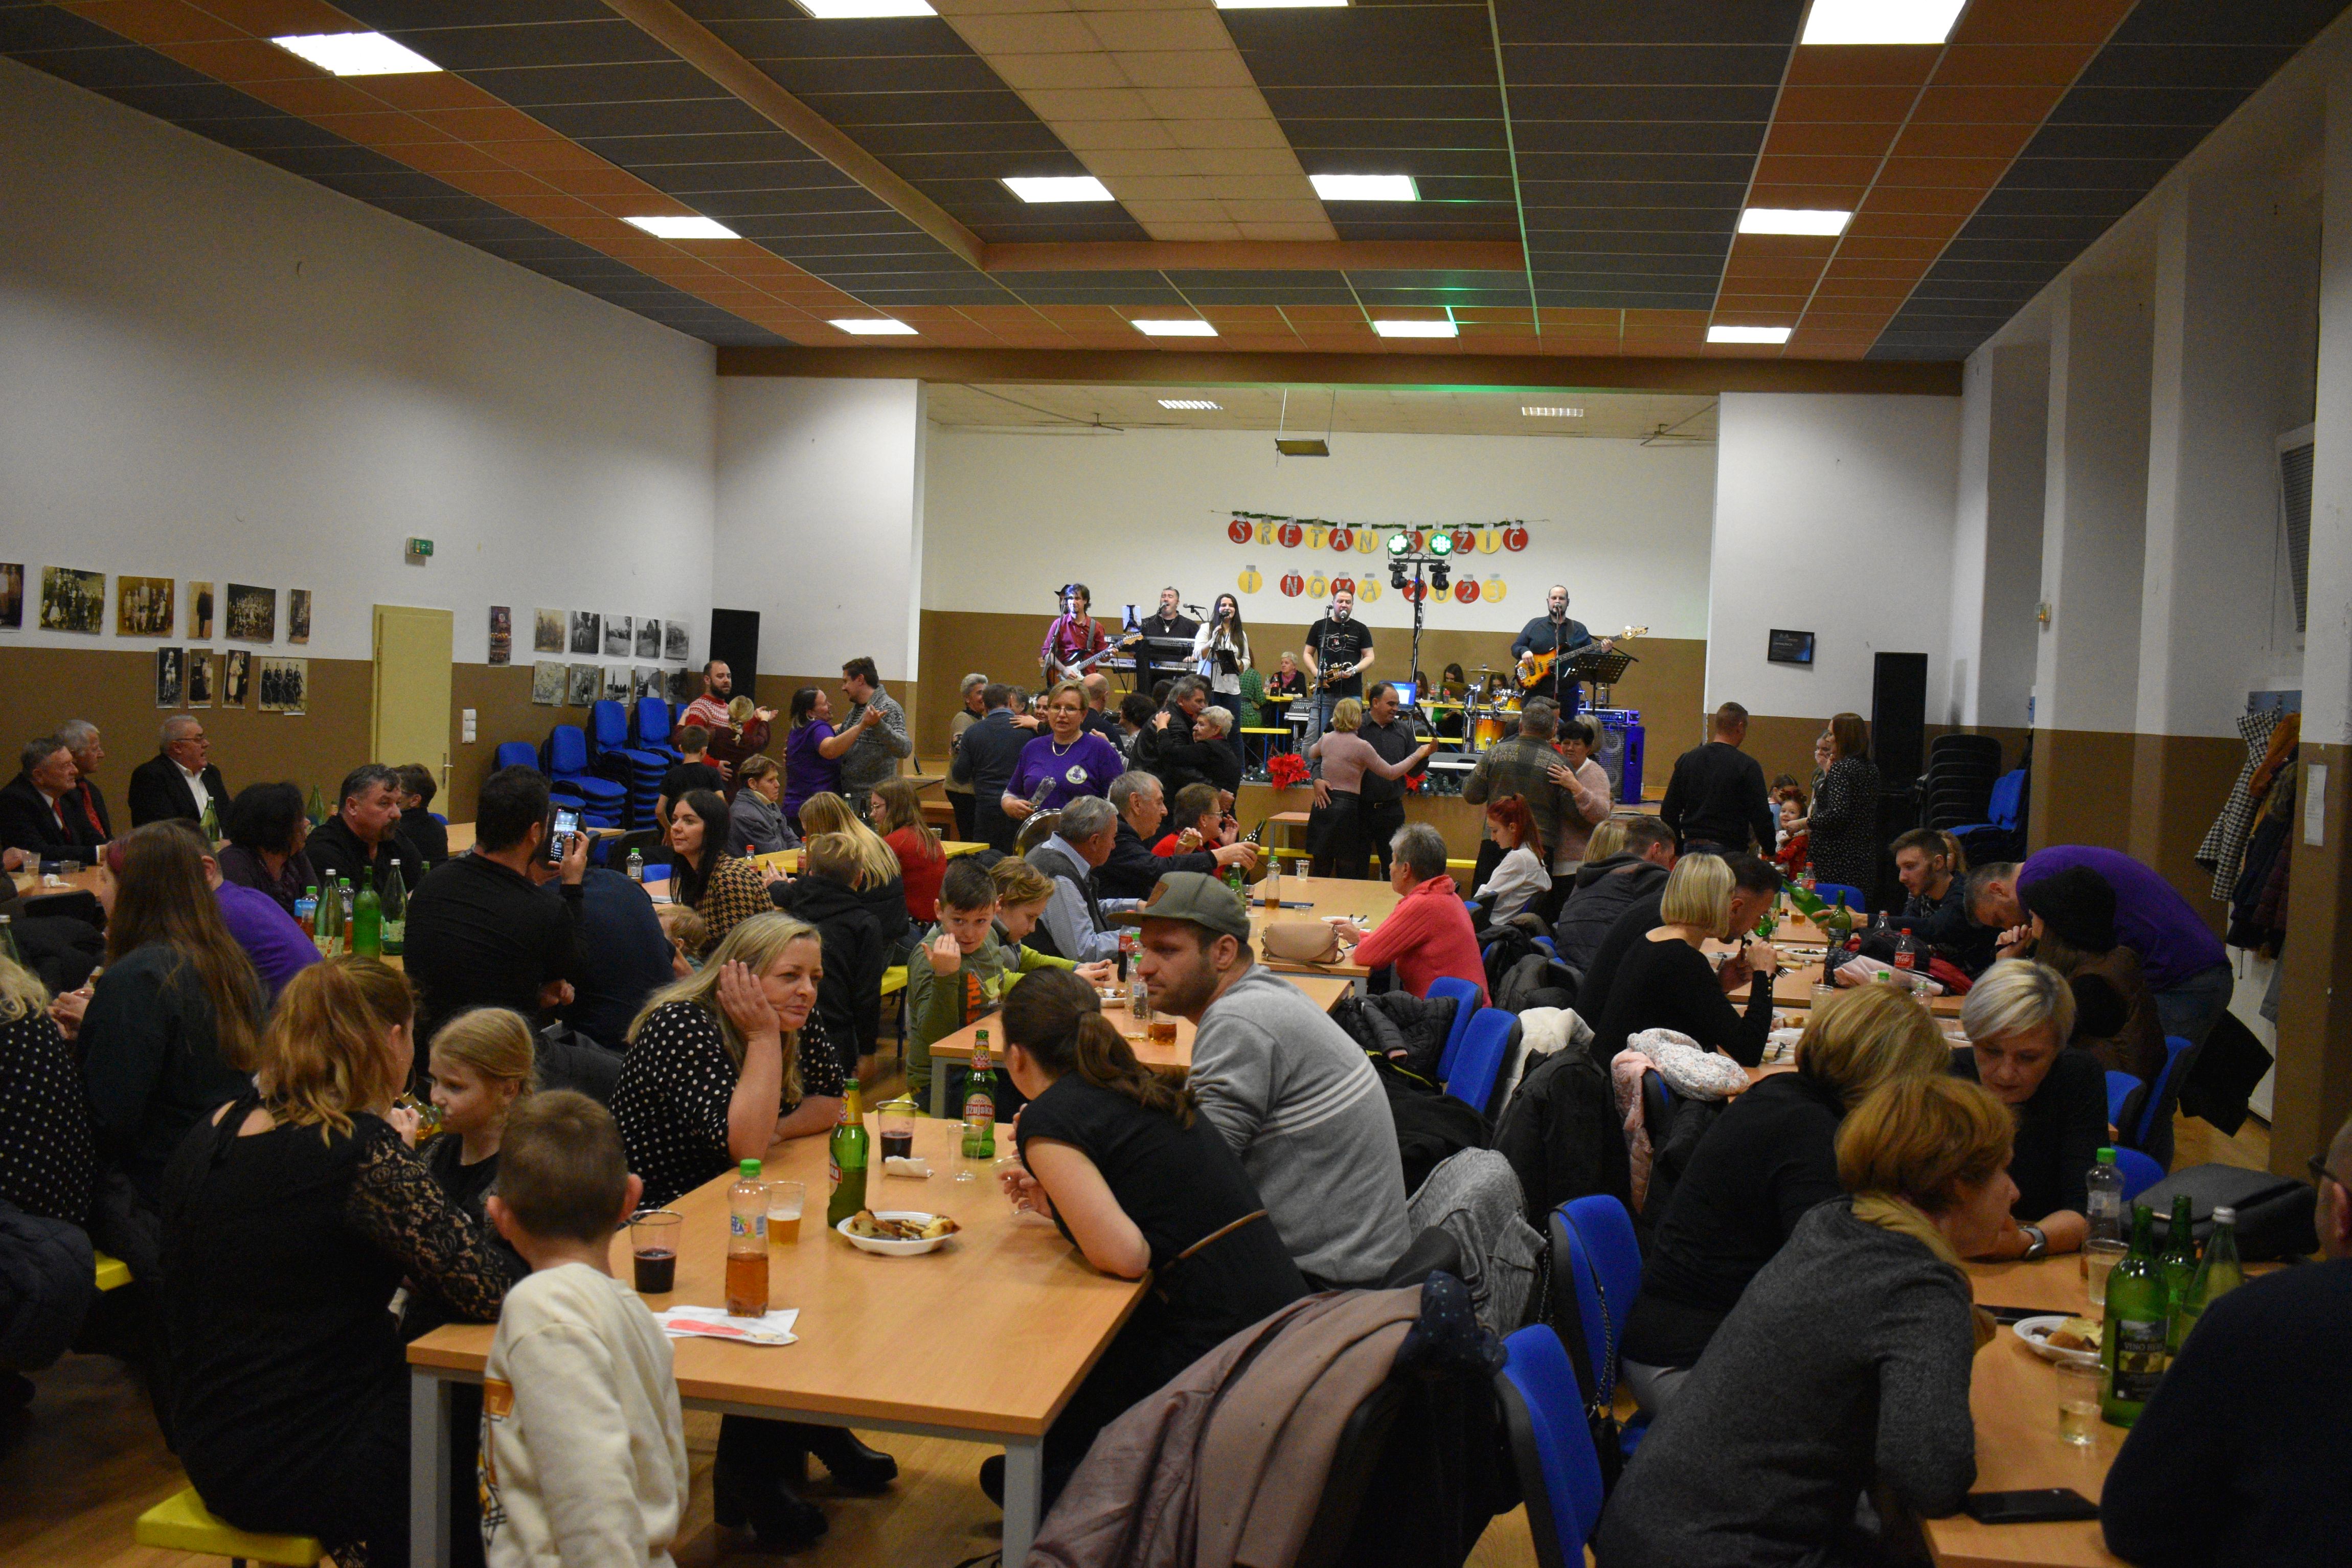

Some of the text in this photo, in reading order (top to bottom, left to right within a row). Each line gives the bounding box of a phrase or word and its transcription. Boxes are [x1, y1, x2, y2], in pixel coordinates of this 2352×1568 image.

[1233, 522, 1521, 553] SRETAN BŽIĆ
[1248, 574, 1252, 594] I
